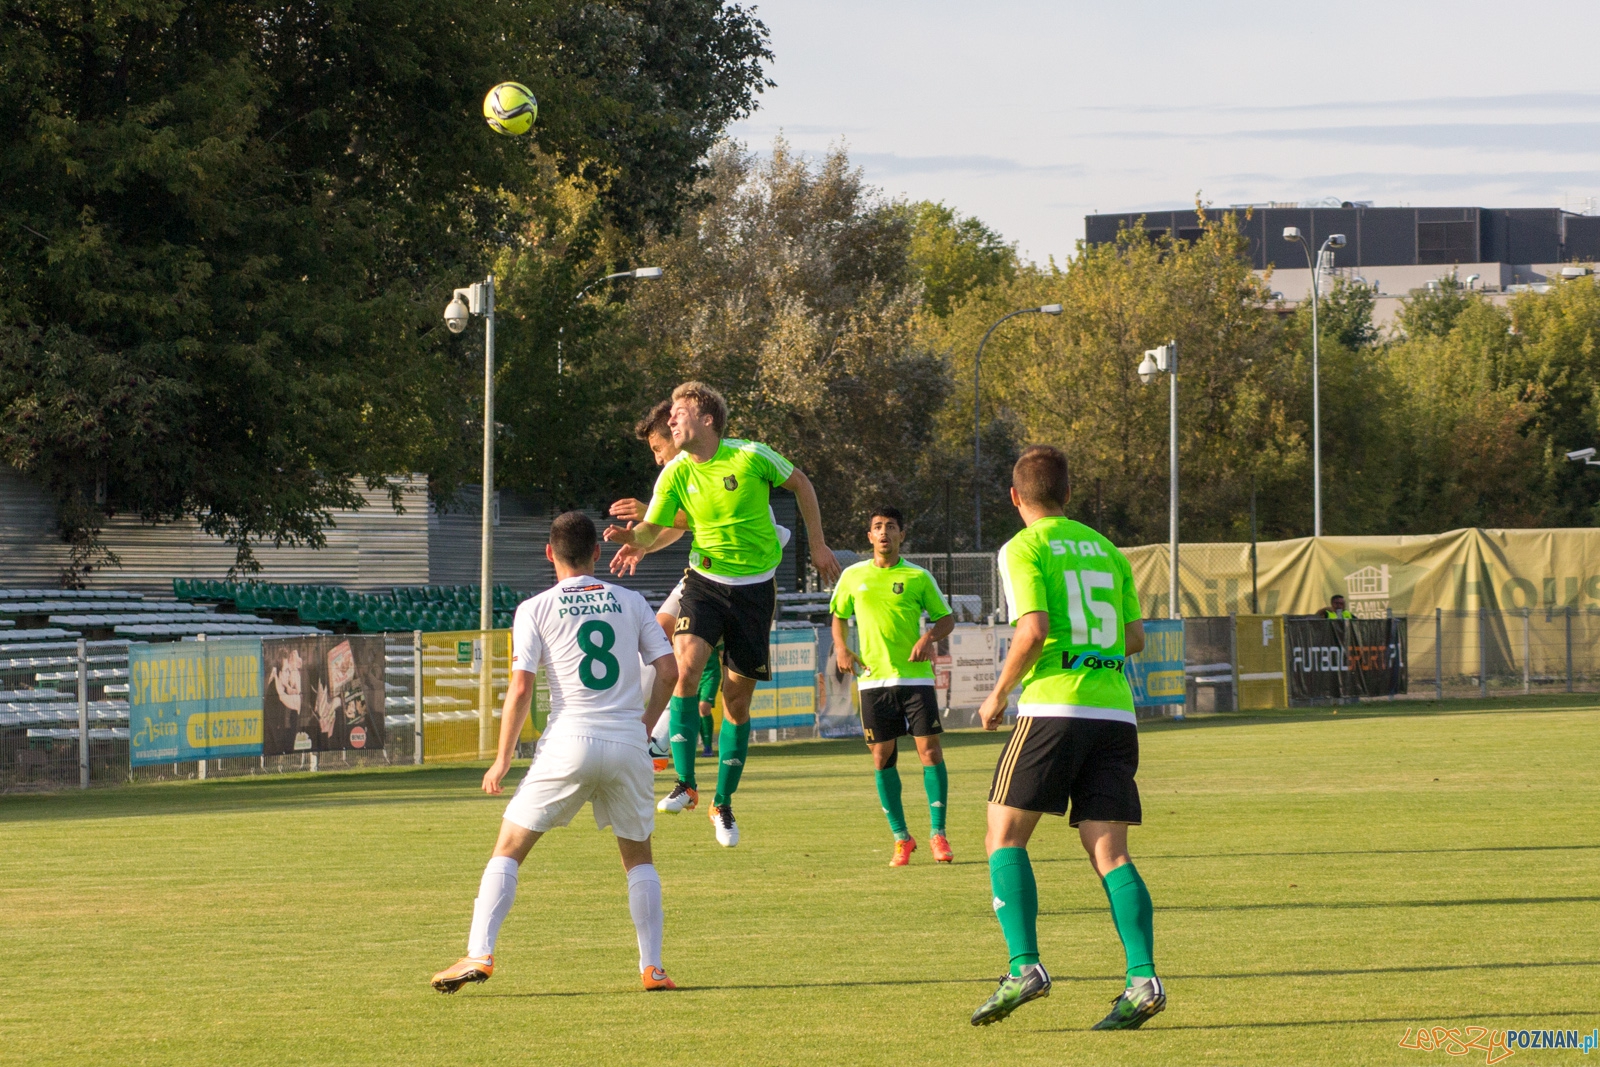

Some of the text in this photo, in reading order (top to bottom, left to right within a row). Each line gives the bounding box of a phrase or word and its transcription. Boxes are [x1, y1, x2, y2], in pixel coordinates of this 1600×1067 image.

[1050, 539, 1108, 557] STAL
[559, 591, 616, 604] WARTA
[1349, 601, 1389, 611] FAMILY
[559, 602, 622, 618] POZNAŃ
[1064, 570, 1117, 649] 15
[577, 619, 620, 691] 8
[224, 655, 258, 698] BIUR
[212, 719, 223, 739] 62
[243, 717, 259, 736] 797
